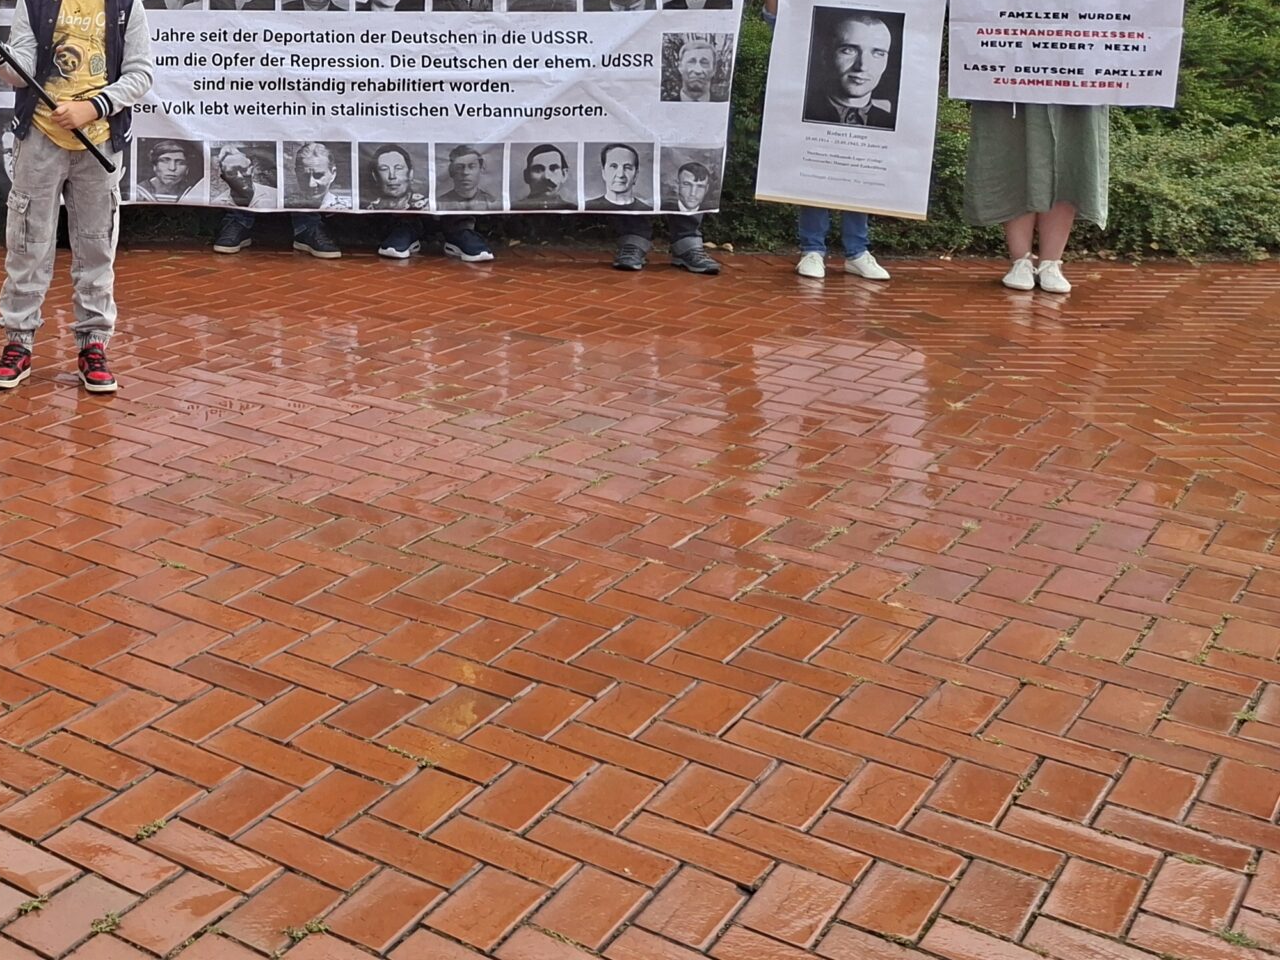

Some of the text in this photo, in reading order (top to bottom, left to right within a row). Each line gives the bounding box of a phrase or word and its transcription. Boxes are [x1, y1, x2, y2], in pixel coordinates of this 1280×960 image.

[1000, 11, 1068, 19] FAMILIEN
[151, 28, 593, 46] Jahre seit der Deportation der Deutschen in die UdSSR.
[1032, 42, 1094, 50] WIEDER?
[156, 52, 653, 71] um die Opfer der Repression. Die Deutschen der ehem. UdSSR
[964, 64, 1006, 72] LASST
[1014, 66, 1084, 75] DEUTSCHE
[194, 77, 514, 95] sind nie vollständig rehabilitiert worden.
[994, 78, 1129, 88] ZUSAMMENBLEIBEN!
[133, 101, 607, 120] ser Volk lebt weiterhin in stalinistischen Verbannungsorten.
